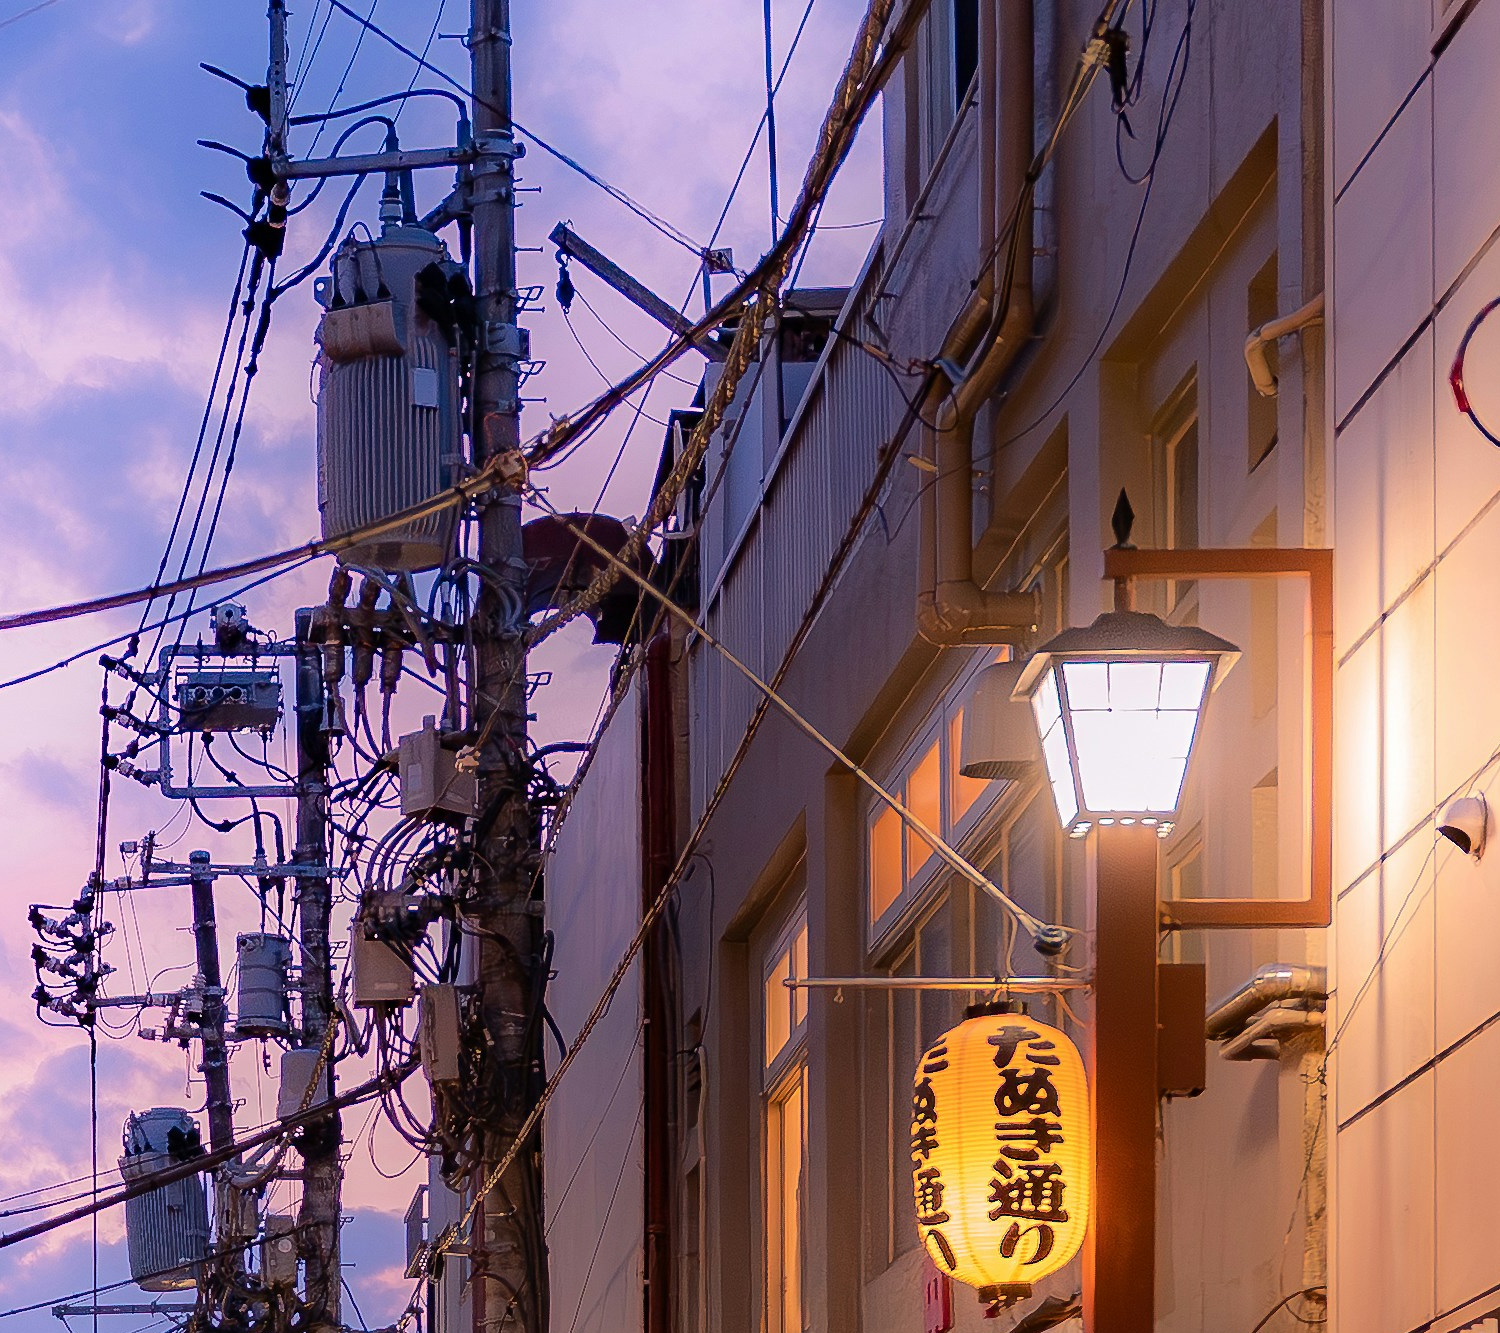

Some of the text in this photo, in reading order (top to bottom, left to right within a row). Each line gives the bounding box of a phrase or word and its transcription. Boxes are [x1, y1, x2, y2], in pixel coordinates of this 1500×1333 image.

[987, 1025, 1069, 1265] たぬき通り
